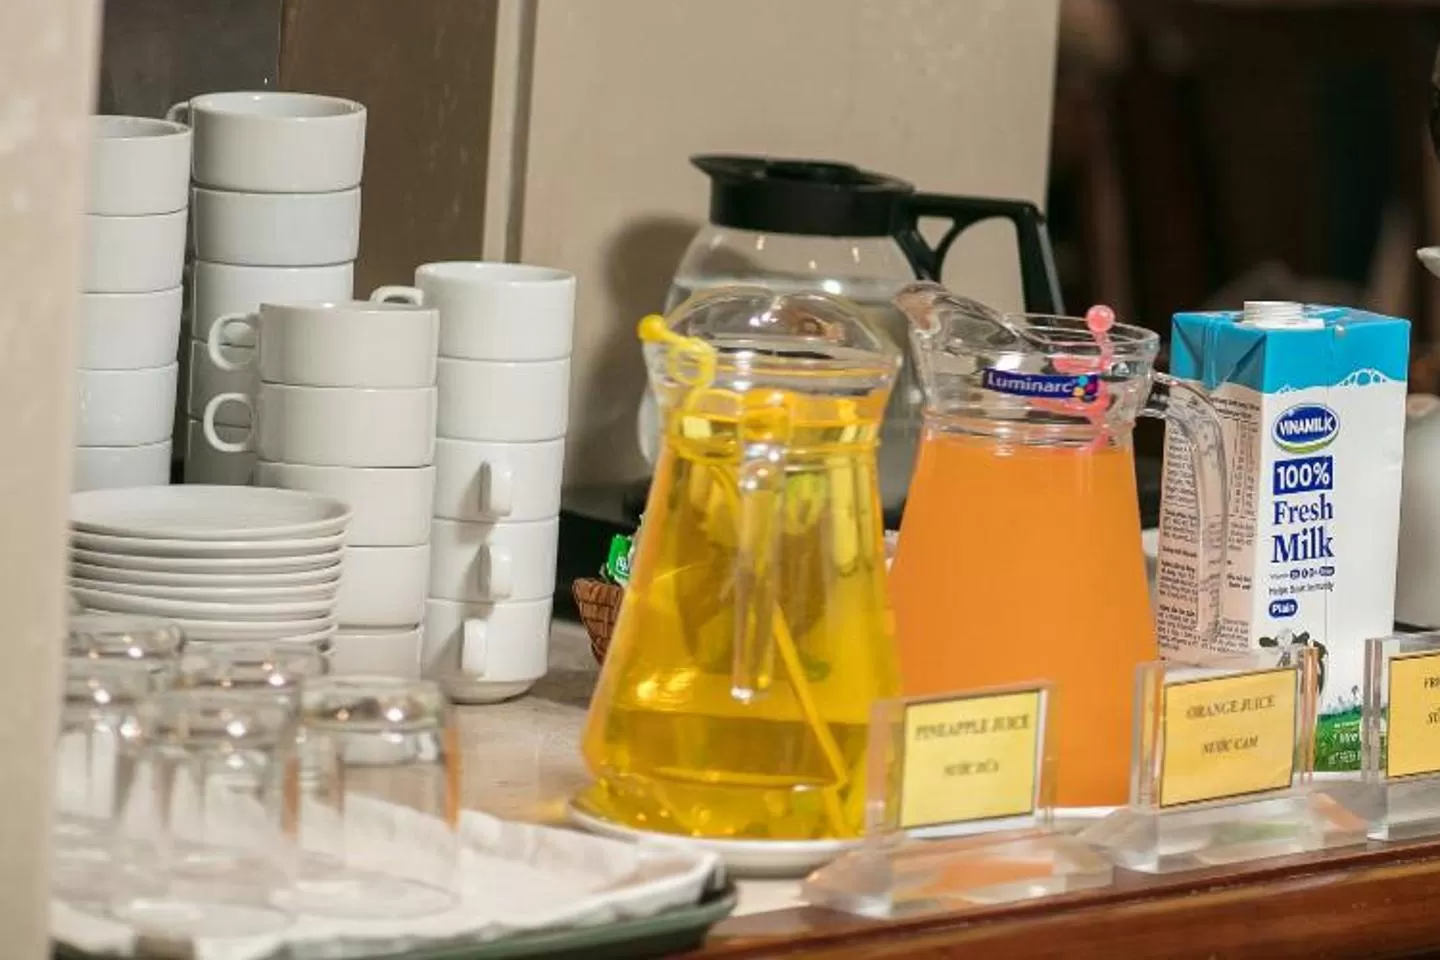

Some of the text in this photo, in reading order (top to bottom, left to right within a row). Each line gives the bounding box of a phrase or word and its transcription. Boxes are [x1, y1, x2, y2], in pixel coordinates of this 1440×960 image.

[988, 371, 1074, 393] Luminarc
[1279, 416, 1335, 437] VINAMILK
[1276, 461, 1331, 491] 100%
[1272, 493, 1334, 526] Fresh
[1270, 525, 1336, 564] Milk
[1186, 694, 1276, 719] ORANGE JUICE
[915, 719, 988, 740] PINEAPPLE
